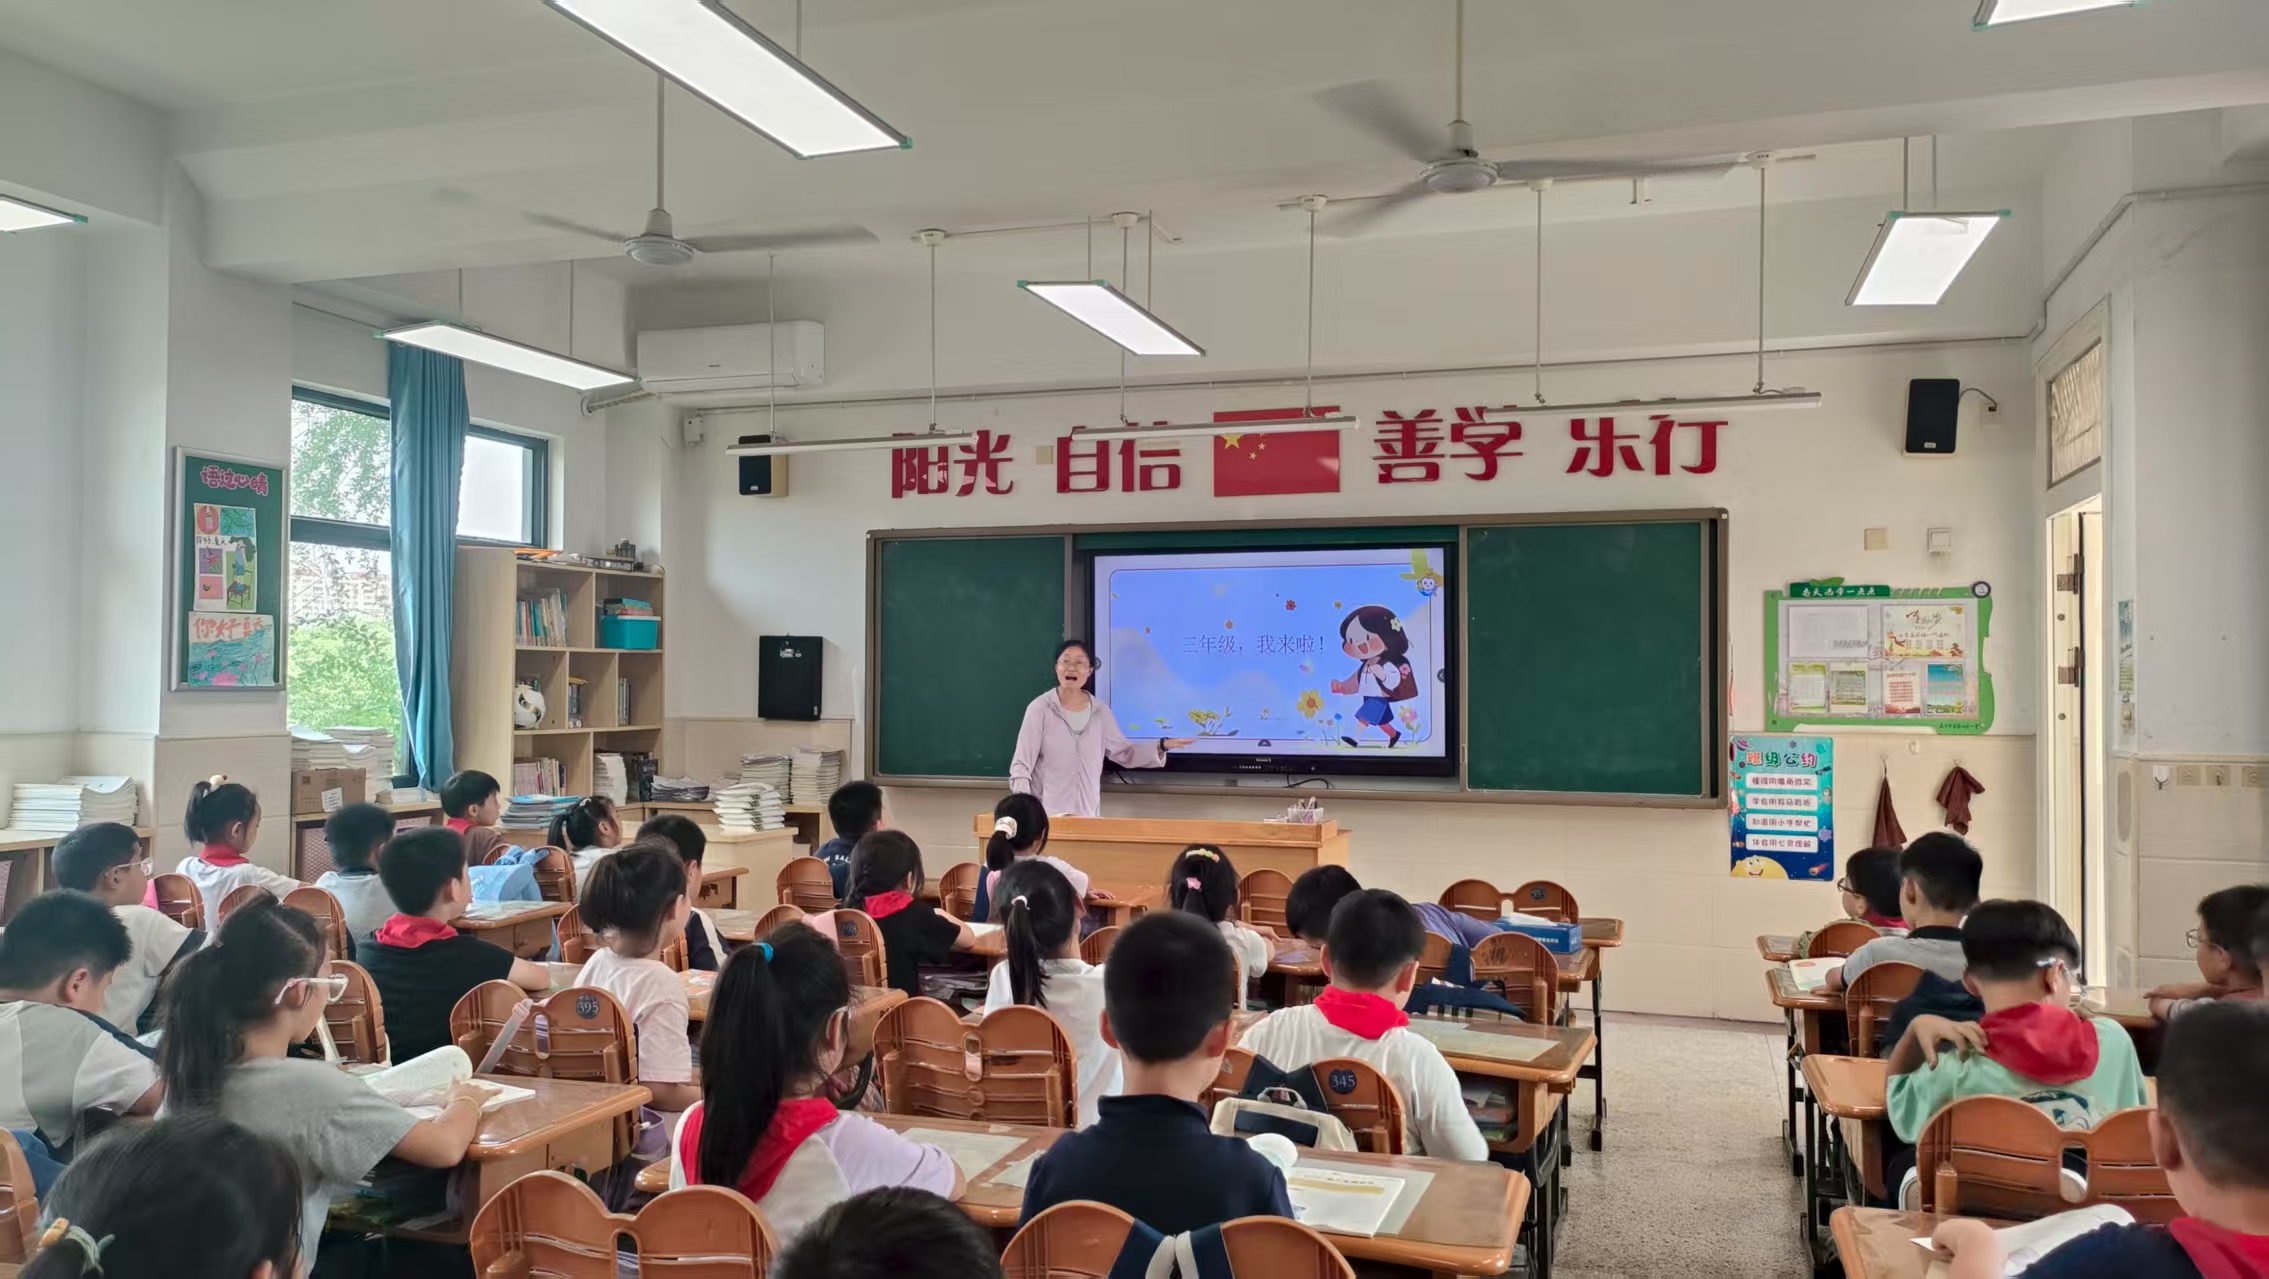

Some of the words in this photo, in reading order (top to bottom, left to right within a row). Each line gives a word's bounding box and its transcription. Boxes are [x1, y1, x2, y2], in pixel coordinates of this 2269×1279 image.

[892, 429, 1013, 498] 阳光
[1056, 421, 1181, 493] 自信
[1372, 405, 1524, 484] 善学
[1566, 398, 1729, 477] 乐行
[1747, 751, 1817, 768] 班级公约
[1331, 1074, 1356, 1088] 345
